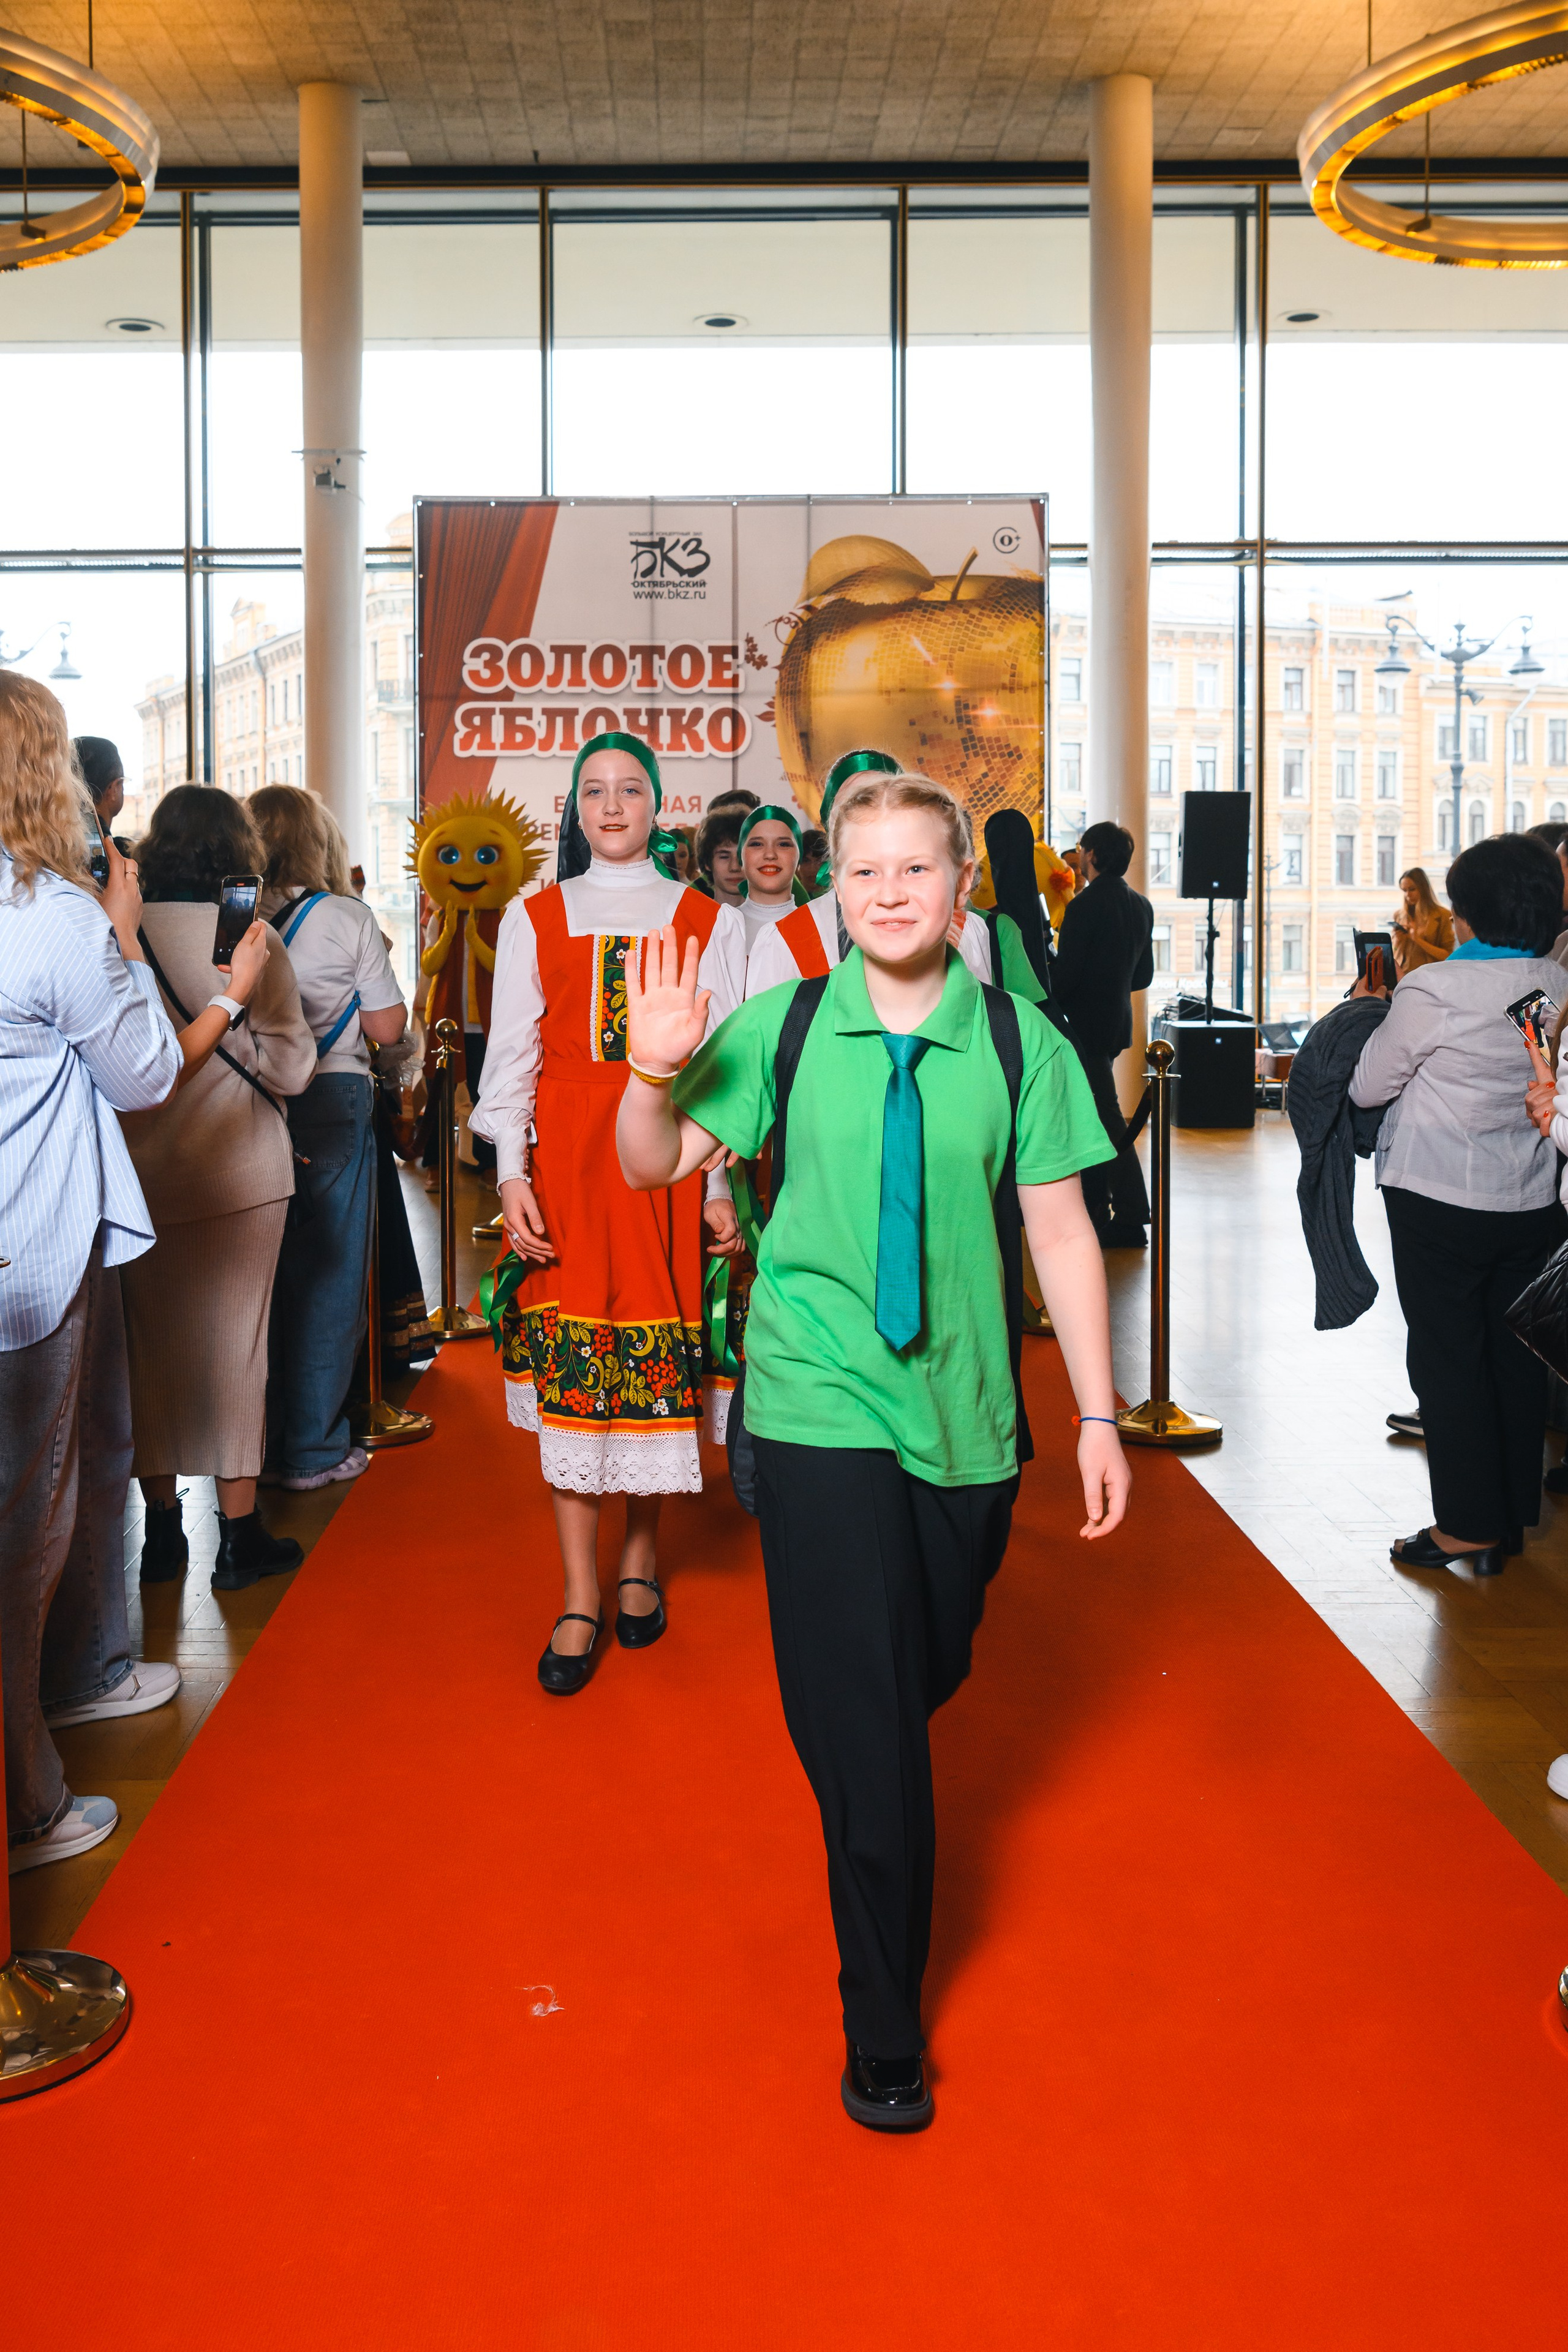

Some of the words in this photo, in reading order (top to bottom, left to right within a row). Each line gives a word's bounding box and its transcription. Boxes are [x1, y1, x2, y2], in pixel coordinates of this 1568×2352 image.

[630, 537, 710, 579] БКЗ
[633, 589, 706, 600] www.bkz.ru
[467, 644, 739, 688] ЗОЛОТОЕ
[459, 707, 746, 753] ЯБЛОЧКО
